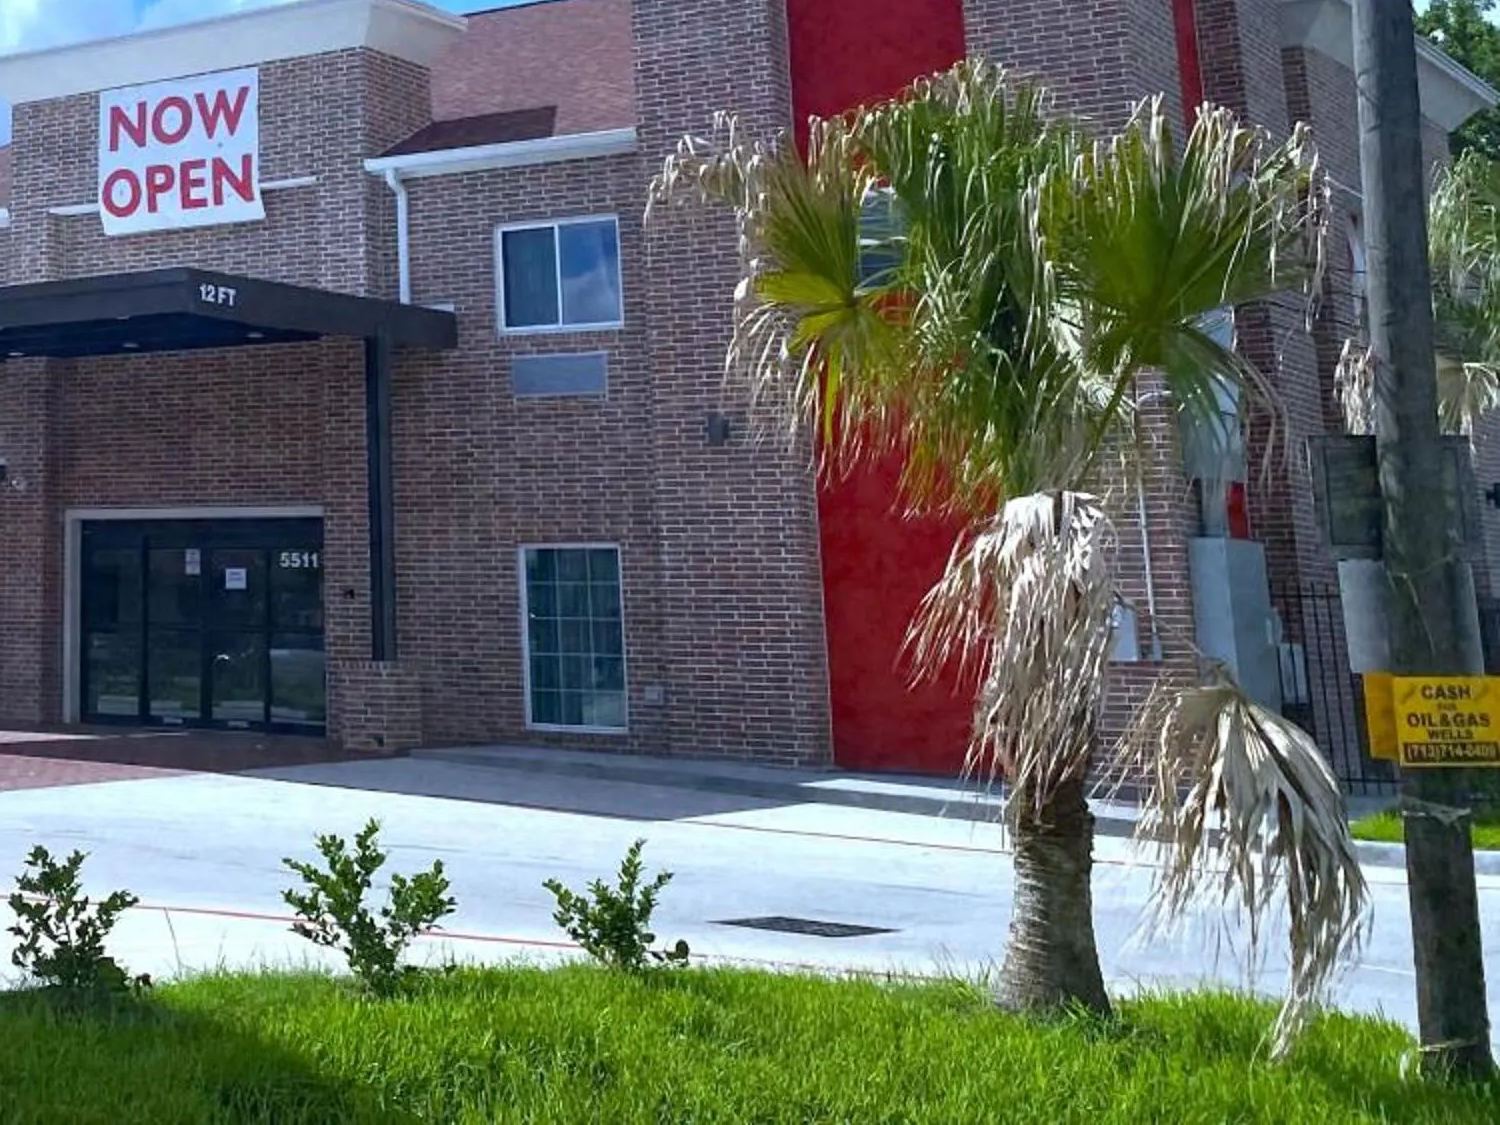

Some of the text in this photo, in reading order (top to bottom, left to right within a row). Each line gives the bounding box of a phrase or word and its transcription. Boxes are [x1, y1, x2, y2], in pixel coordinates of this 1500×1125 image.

[108, 86, 250, 152] NOW
[102, 154, 256, 217] OPEN
[280, 552, 319, 568] 5511
[1421, 685, 1472, 699] CASH
[1427, 729, 1473, 740] WELLS
